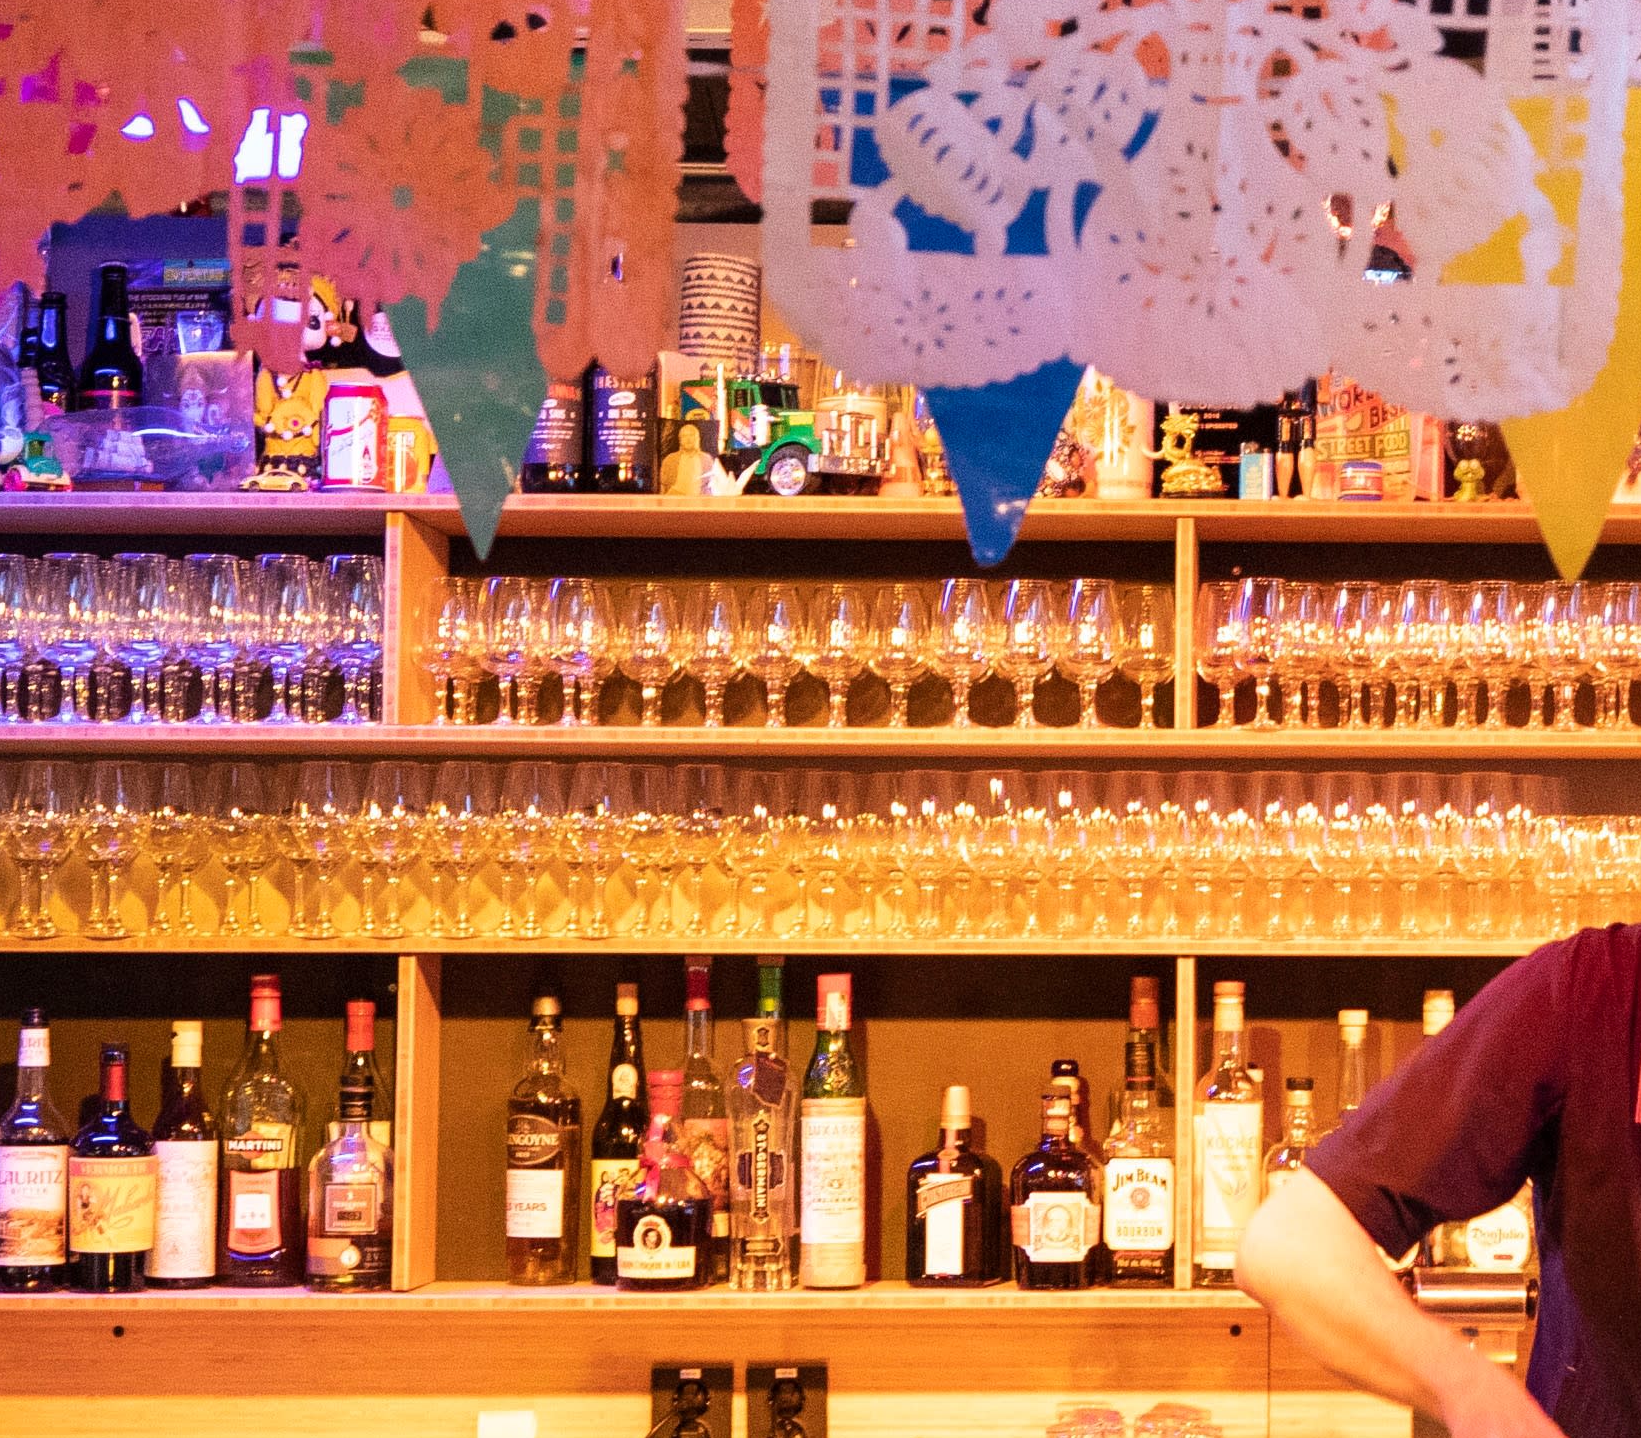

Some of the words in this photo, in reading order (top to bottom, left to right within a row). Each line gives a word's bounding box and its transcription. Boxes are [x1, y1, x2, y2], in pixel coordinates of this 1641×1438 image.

[1315, 434, 1371, 461] STREET
[1374, 431, 1408, 457] FOOD
[227, 1139, 282, 1152] MARTINI
[1112, 1173, 1134, 1193] JIM
[1136, 1168, 1168, 1191] BEAM
[1116, 1226, 1164, 1237] BOURBON
